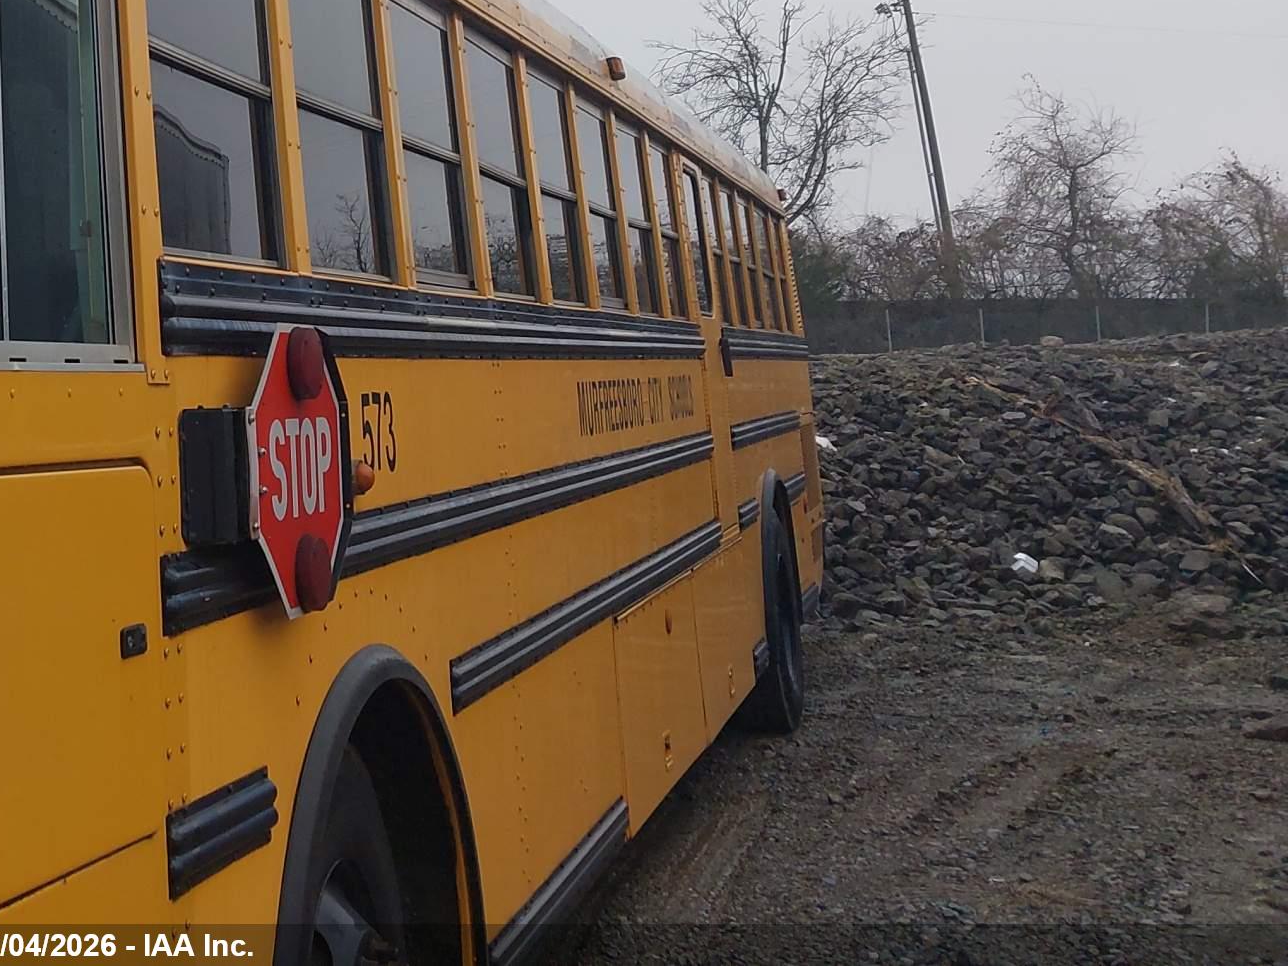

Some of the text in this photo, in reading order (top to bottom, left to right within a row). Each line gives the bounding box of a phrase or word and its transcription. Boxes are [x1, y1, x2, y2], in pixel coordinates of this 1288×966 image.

[361, 392, 396, 472] 573
[576, 377, 645, 437] MURFREESBORO
[268, 416, 332, 521] STOP
